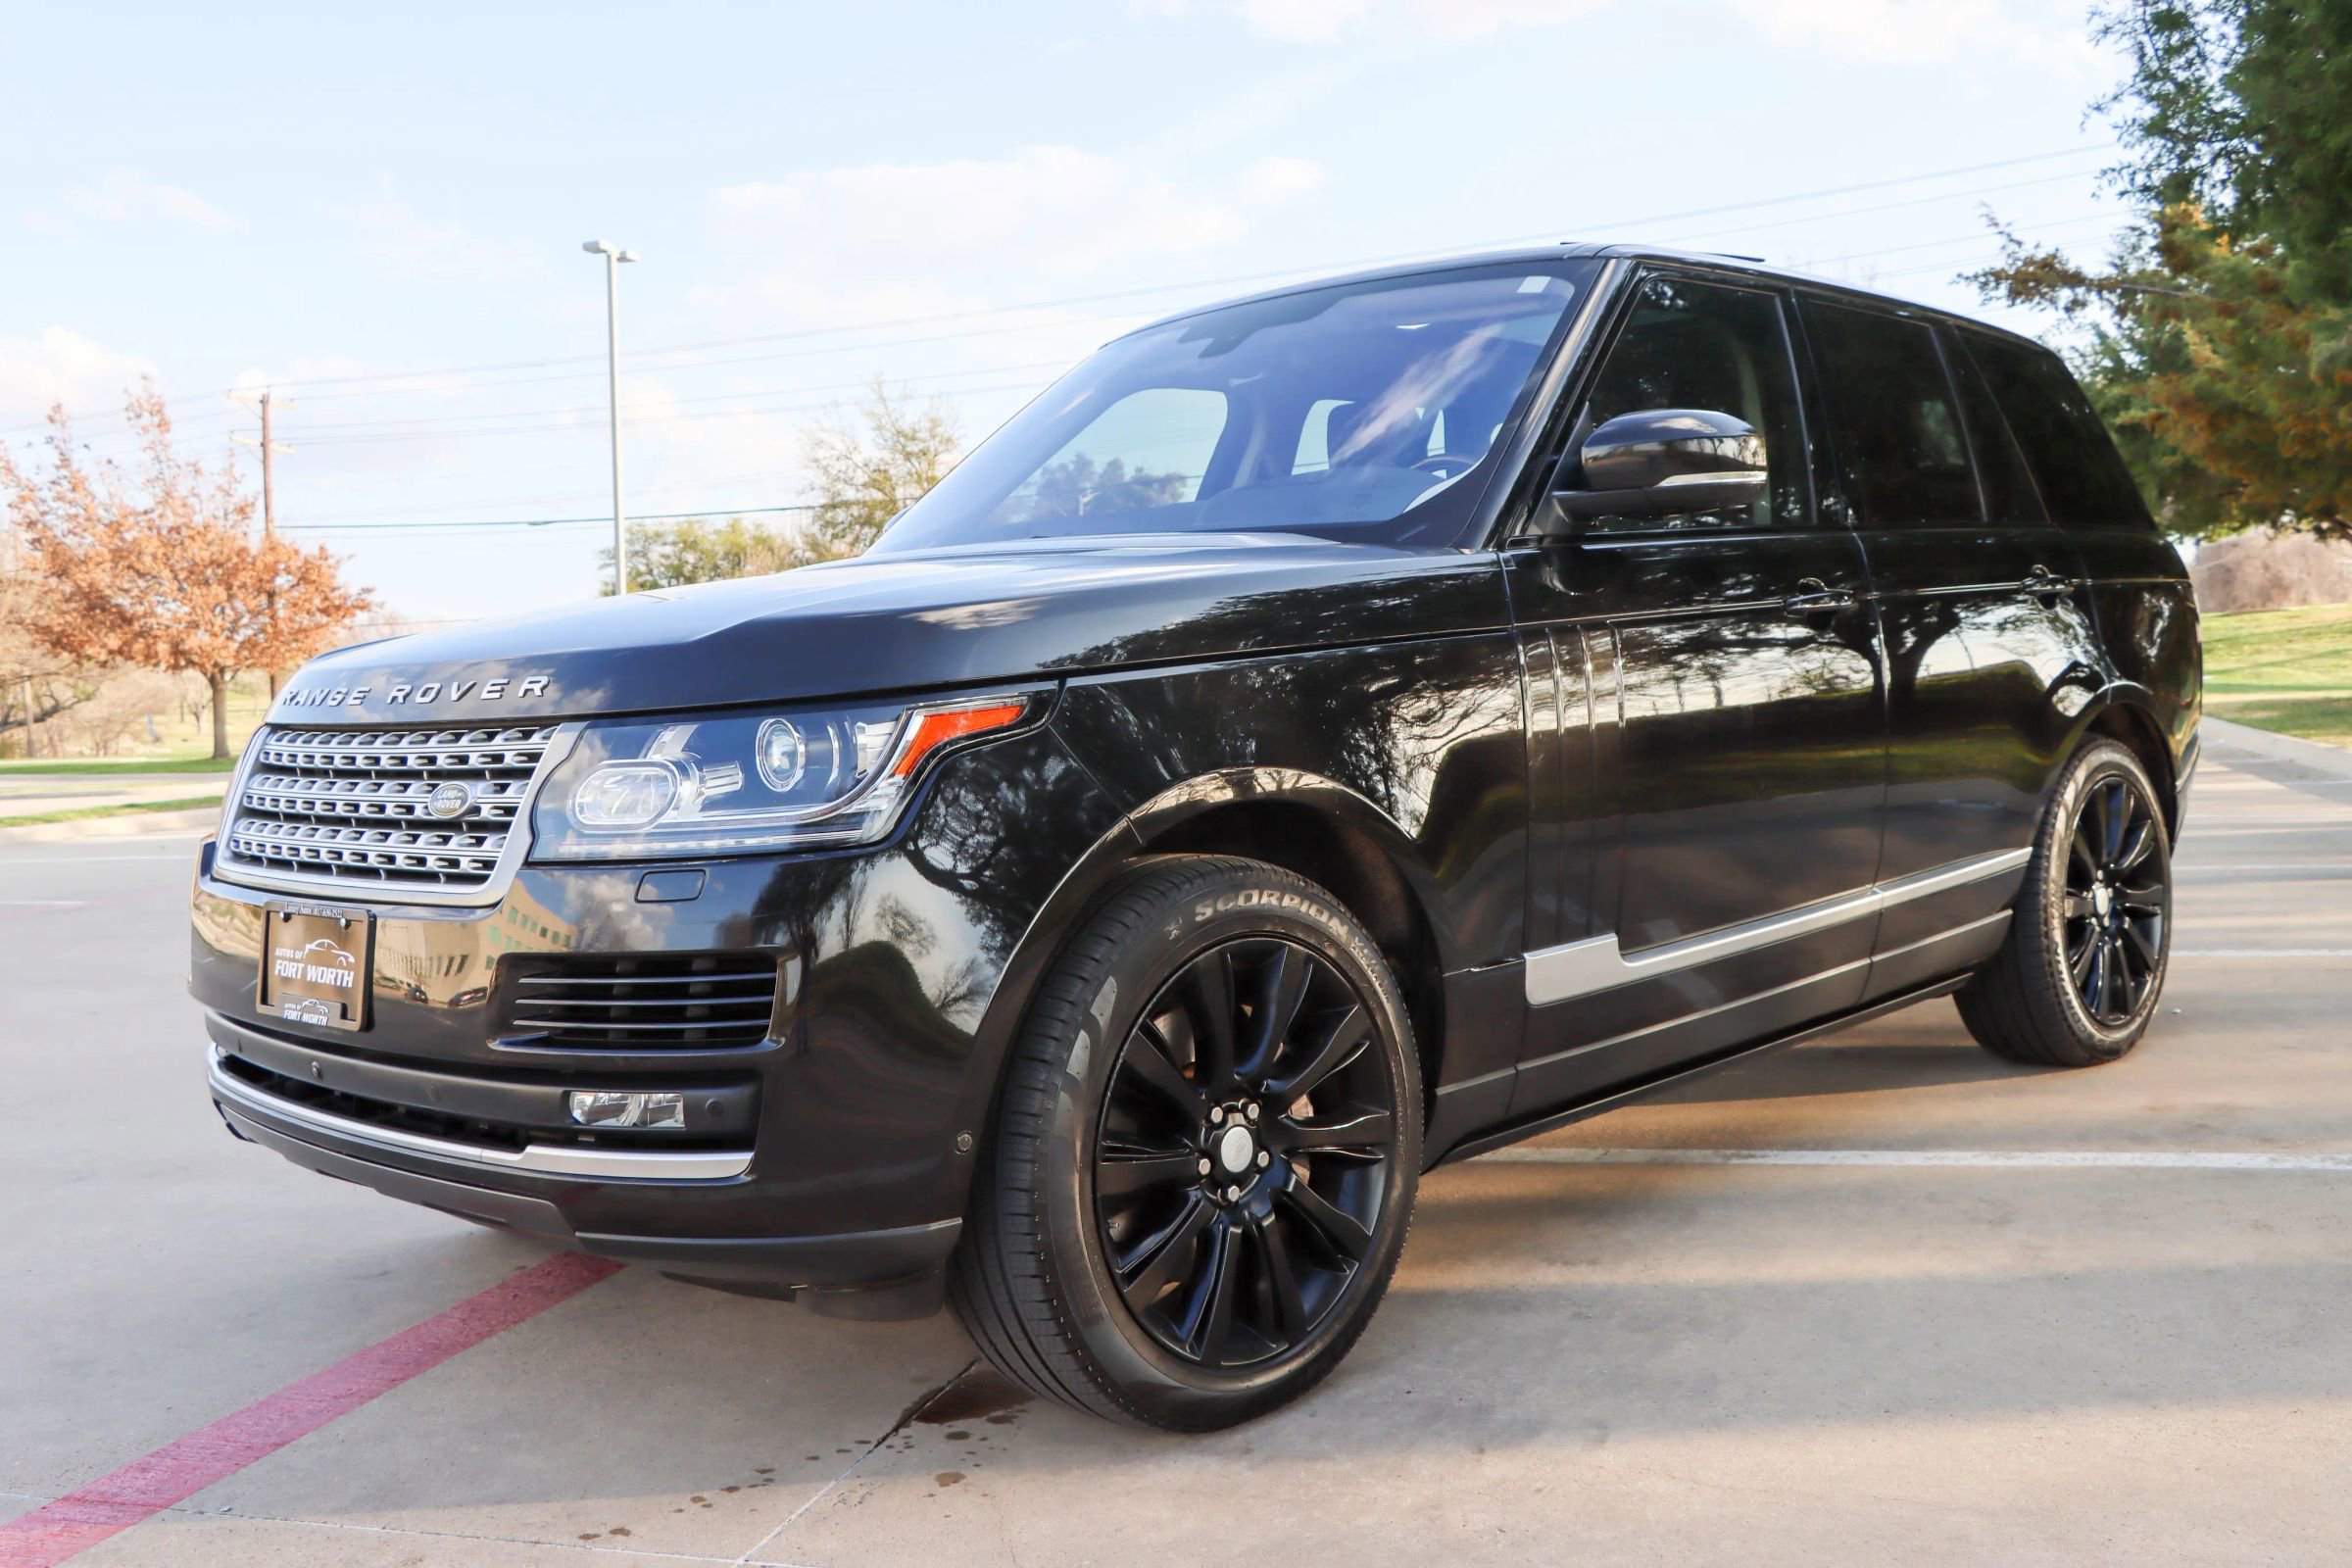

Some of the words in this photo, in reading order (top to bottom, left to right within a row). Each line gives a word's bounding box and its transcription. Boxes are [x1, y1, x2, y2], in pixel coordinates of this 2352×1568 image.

[281, 686, 371, 707] RANGE
[386, 675, 551, 706] ROVER
[436, 788, 458, 800] LAND
[435, 799, 462, 809] ROVER
[1195, 889, 1349, 941] SCORPION
[274, 947, 294, 958] AUTOS
[295, 950, 303, 959] OF
[274, 959, 305, 980] FORT
[306, 964, 355, 988] WORTH
[283, 1009, 303, 1021] FORT
[302, 1012, 328, 1026] WORTH
